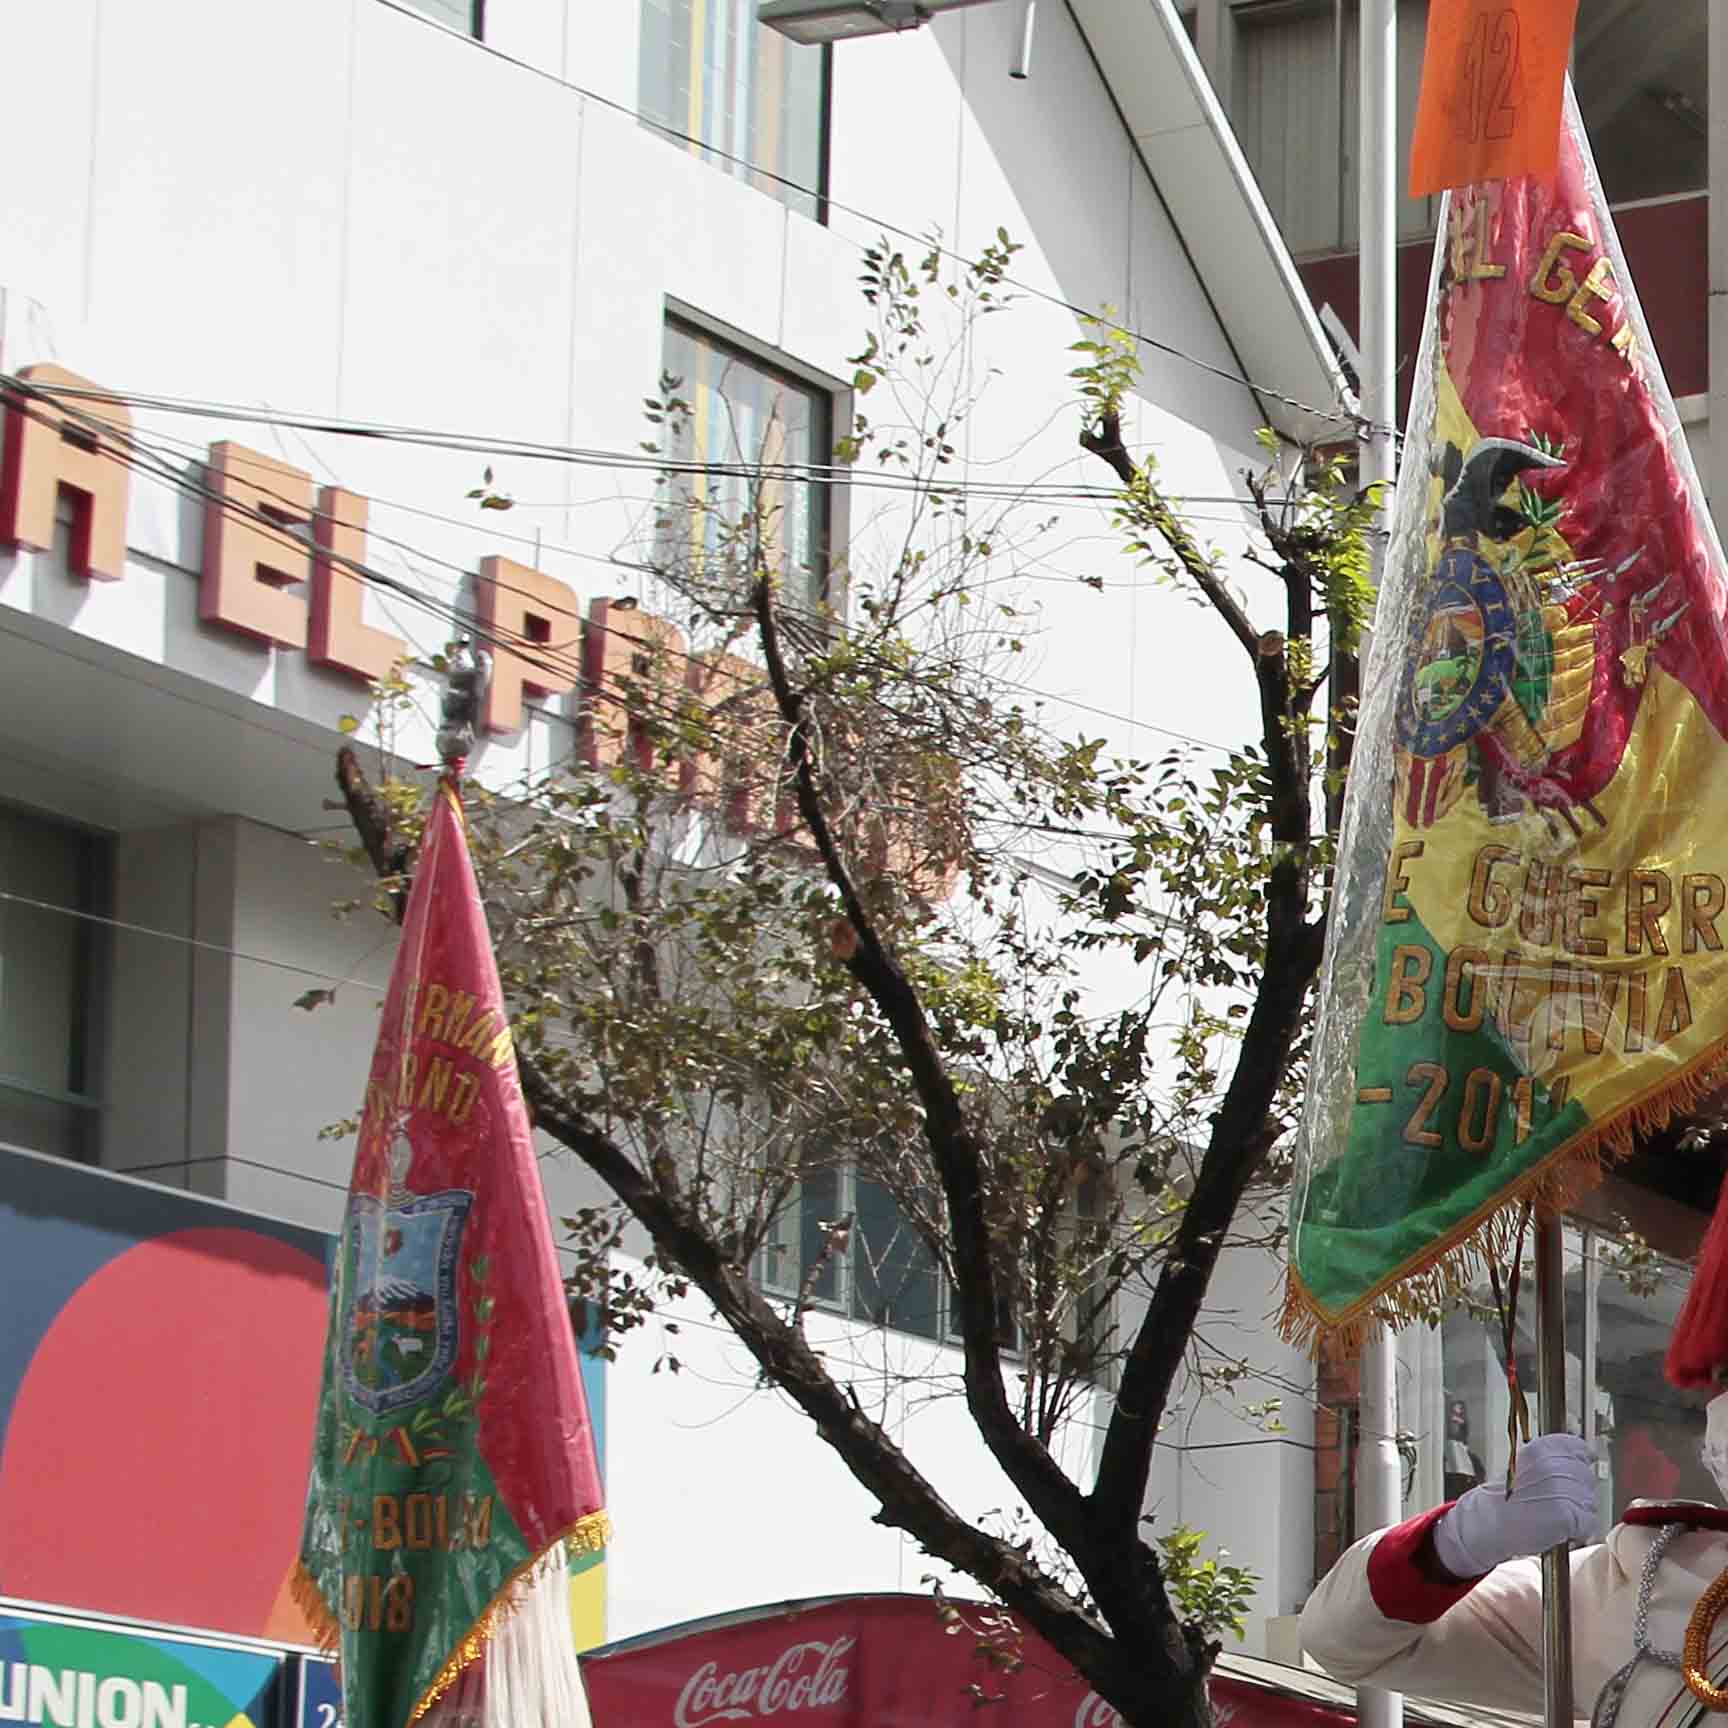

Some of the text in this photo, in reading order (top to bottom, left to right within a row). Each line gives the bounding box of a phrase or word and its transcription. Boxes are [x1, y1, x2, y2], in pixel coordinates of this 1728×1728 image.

[200, 440, 409, 686] EL
[1383, 943, 1694, 1054] BOLIVIA
[674, 1636, 857, 1728] Coca-Cola
